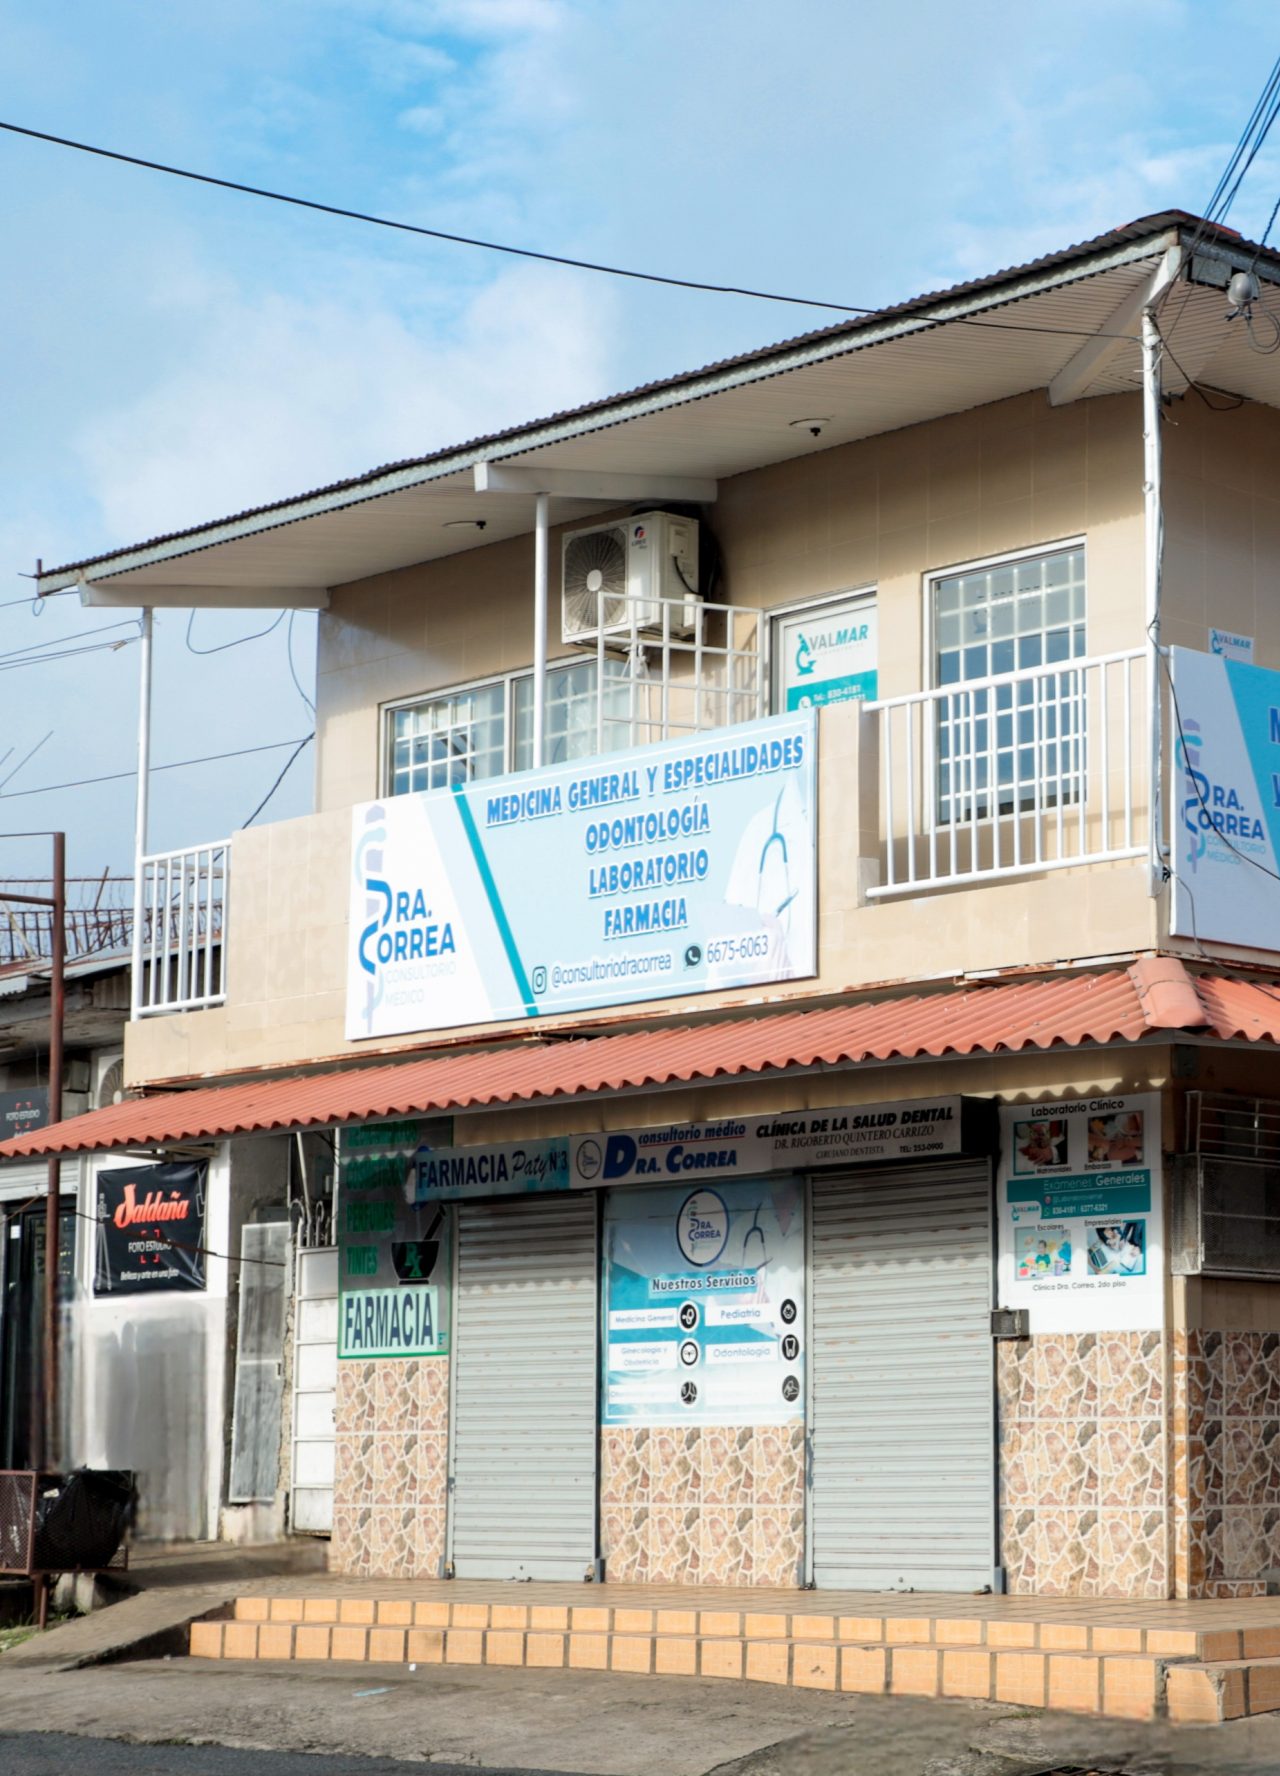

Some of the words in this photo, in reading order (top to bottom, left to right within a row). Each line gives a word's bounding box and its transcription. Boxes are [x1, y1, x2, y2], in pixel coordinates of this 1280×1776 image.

[809, 624, 869, 651] VALMAR
[487, 785, 561, 826] MEDICINA
[568, 770, 639, 809] GENERAL
[646, 766, 658, 794] Y
[664, 735, 804, 790] ESPECIALIDADES
[586, 795, 710, 851] ODONTOLOGÍA
[1182, 798, 1265, 840] CORREA
[589, 848, 709, 896] LABORATORIO
[366, 878, 432, 928] DRA.
[604, 898, 688, 937] FARMACIA
[358, 919, 456, 976] CORREA
[707, 934, 769, 964] 6675-6063
[552, 951, 672, 988] @consultoriodracorrea
[756, 1119, 806, 1138] CLÍNICA
[811, 1118, 828, 1133] DE
[832, 1116, 848, 1131] LA
[853, 1112, 897, 1129] SALUD
[901, 1106, 953, 1125] DENTAL
[1032, 1102, 1087, 1117] Laboratorio
[1089, 1099, 1125, 1112] Clínico
[639, 1124, 701, 1145] consultorio
[704, 1121, 746, 1139] médico
[774, 1138, 788, 1150] DR.
[790, 1133, 841, 1148] RIGOBERTO
[842, 1128, 891, 1144] QUINTERO
[892, 1124, 934, 1139] CARRIZO
[418, 1153, 508, 1190] FARMACIA
[512, 1150, 547, 1182] Paty
[603, 1134, 661, 1180] DRA.
[666, 1145, 738, 1174] CORREA
[1096, 1172, 1145, 1187] Generales
[113, 1183, 190, 1229] Saldaña
[128, 1241, 145, 1253] FOTO
[688, 1229, 721, 1242] CORREA
[653, 1276, 702, 1291] Nuestros
[706, 1273, 756, 1287] Servicios
[345, 1292, 434, 1350] FARMACIA
